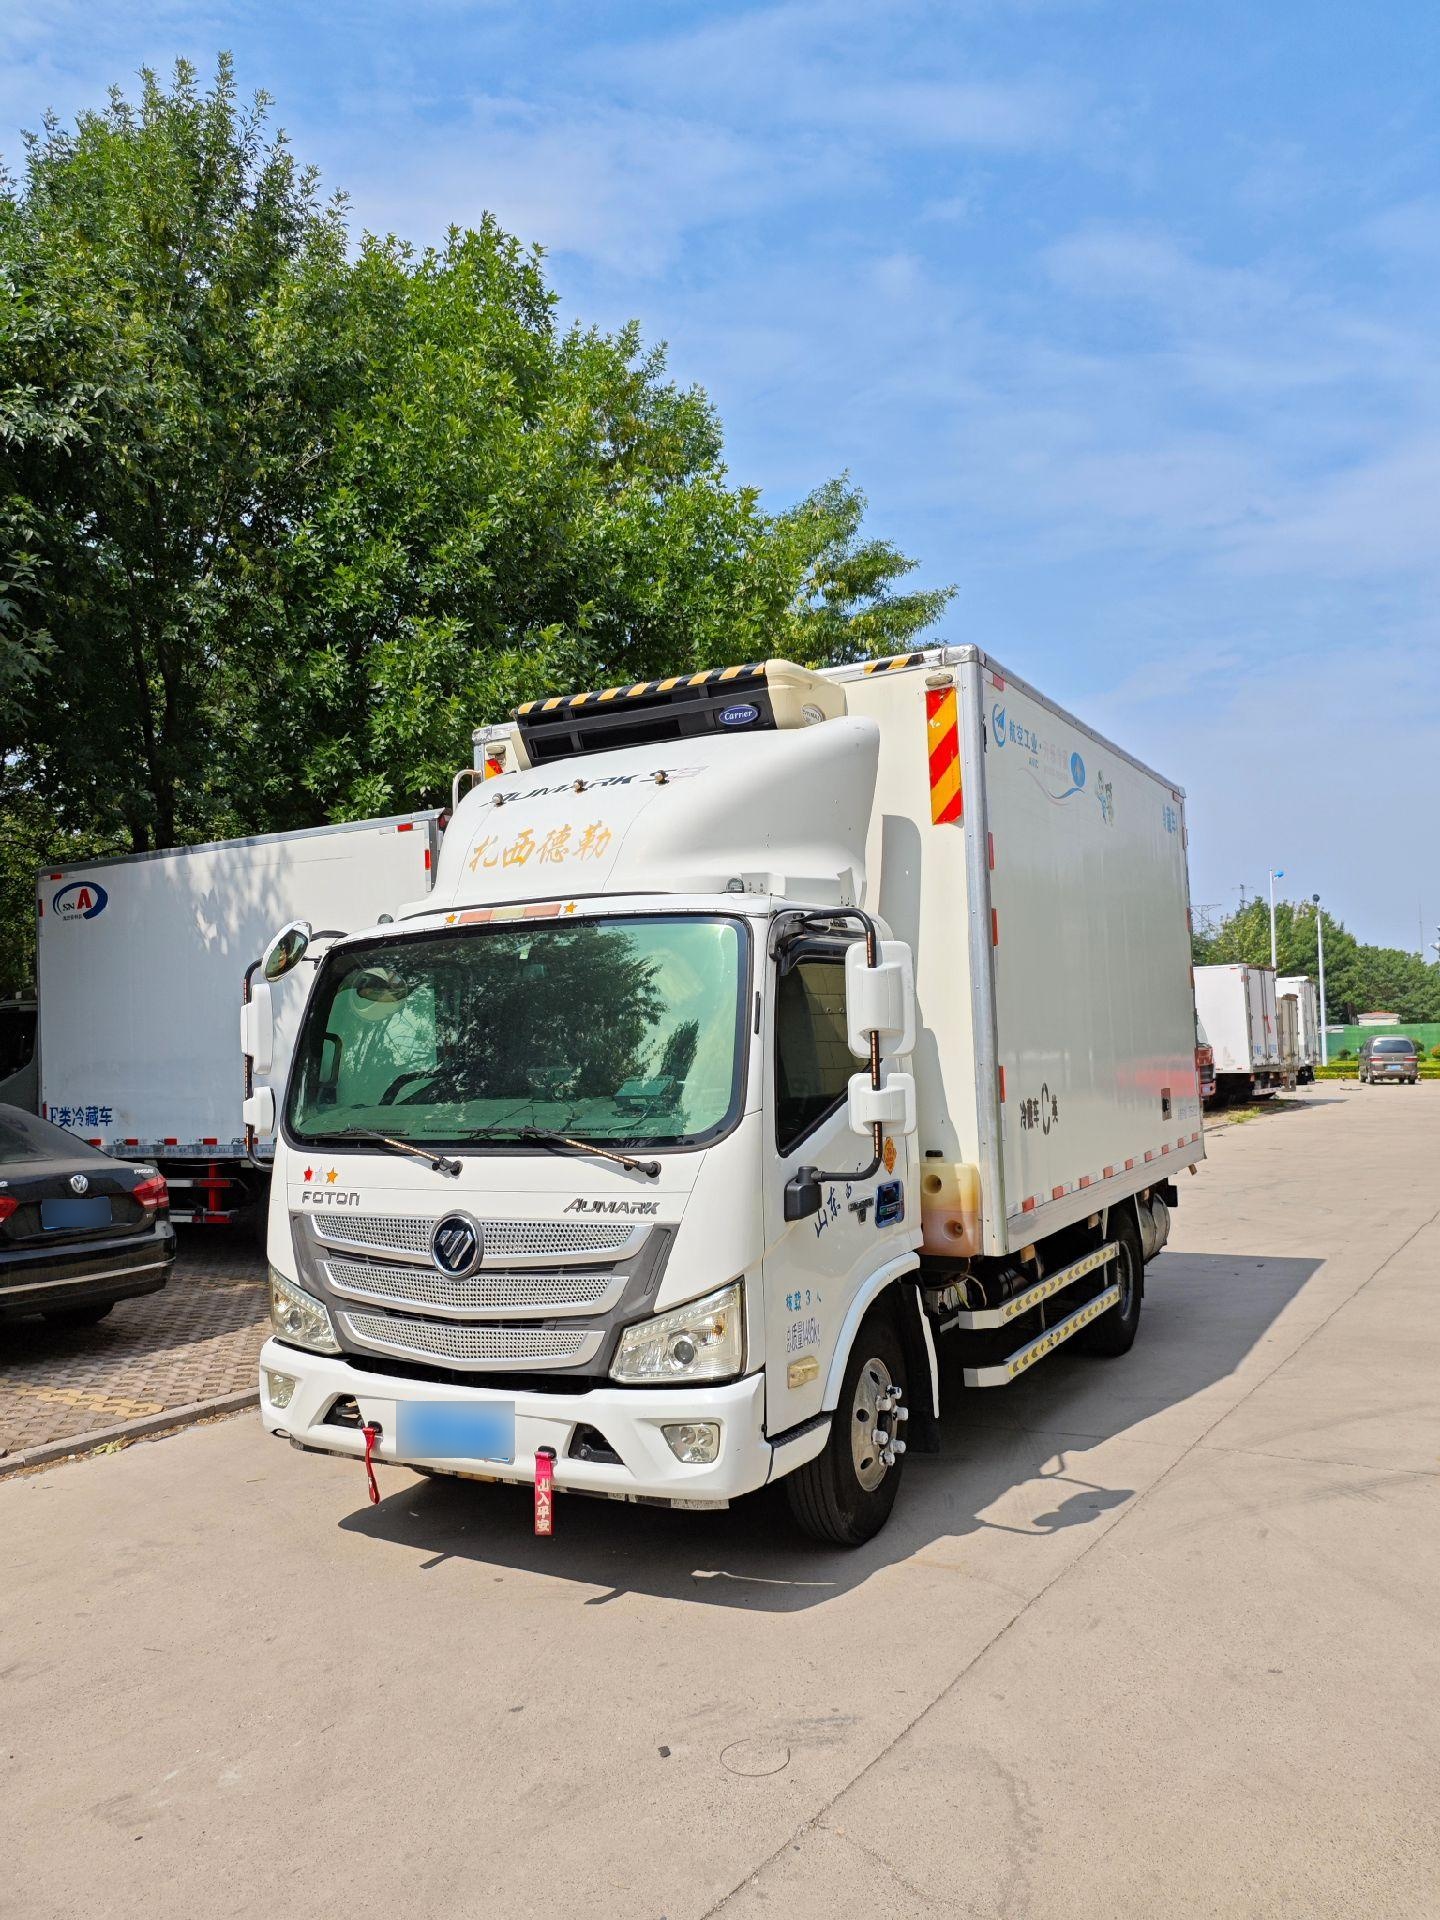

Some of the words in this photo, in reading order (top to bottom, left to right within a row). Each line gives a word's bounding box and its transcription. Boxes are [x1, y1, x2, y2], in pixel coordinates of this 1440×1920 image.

[724, 710, 753, 721] Carrier
[1009, 719, 1039, 755] 航空工业
[469, 819, 612, 872] 扎西德勒
[301, 1191, 361, 1206] FOTON
[562, 1198, 661, 1215] AUMARK
